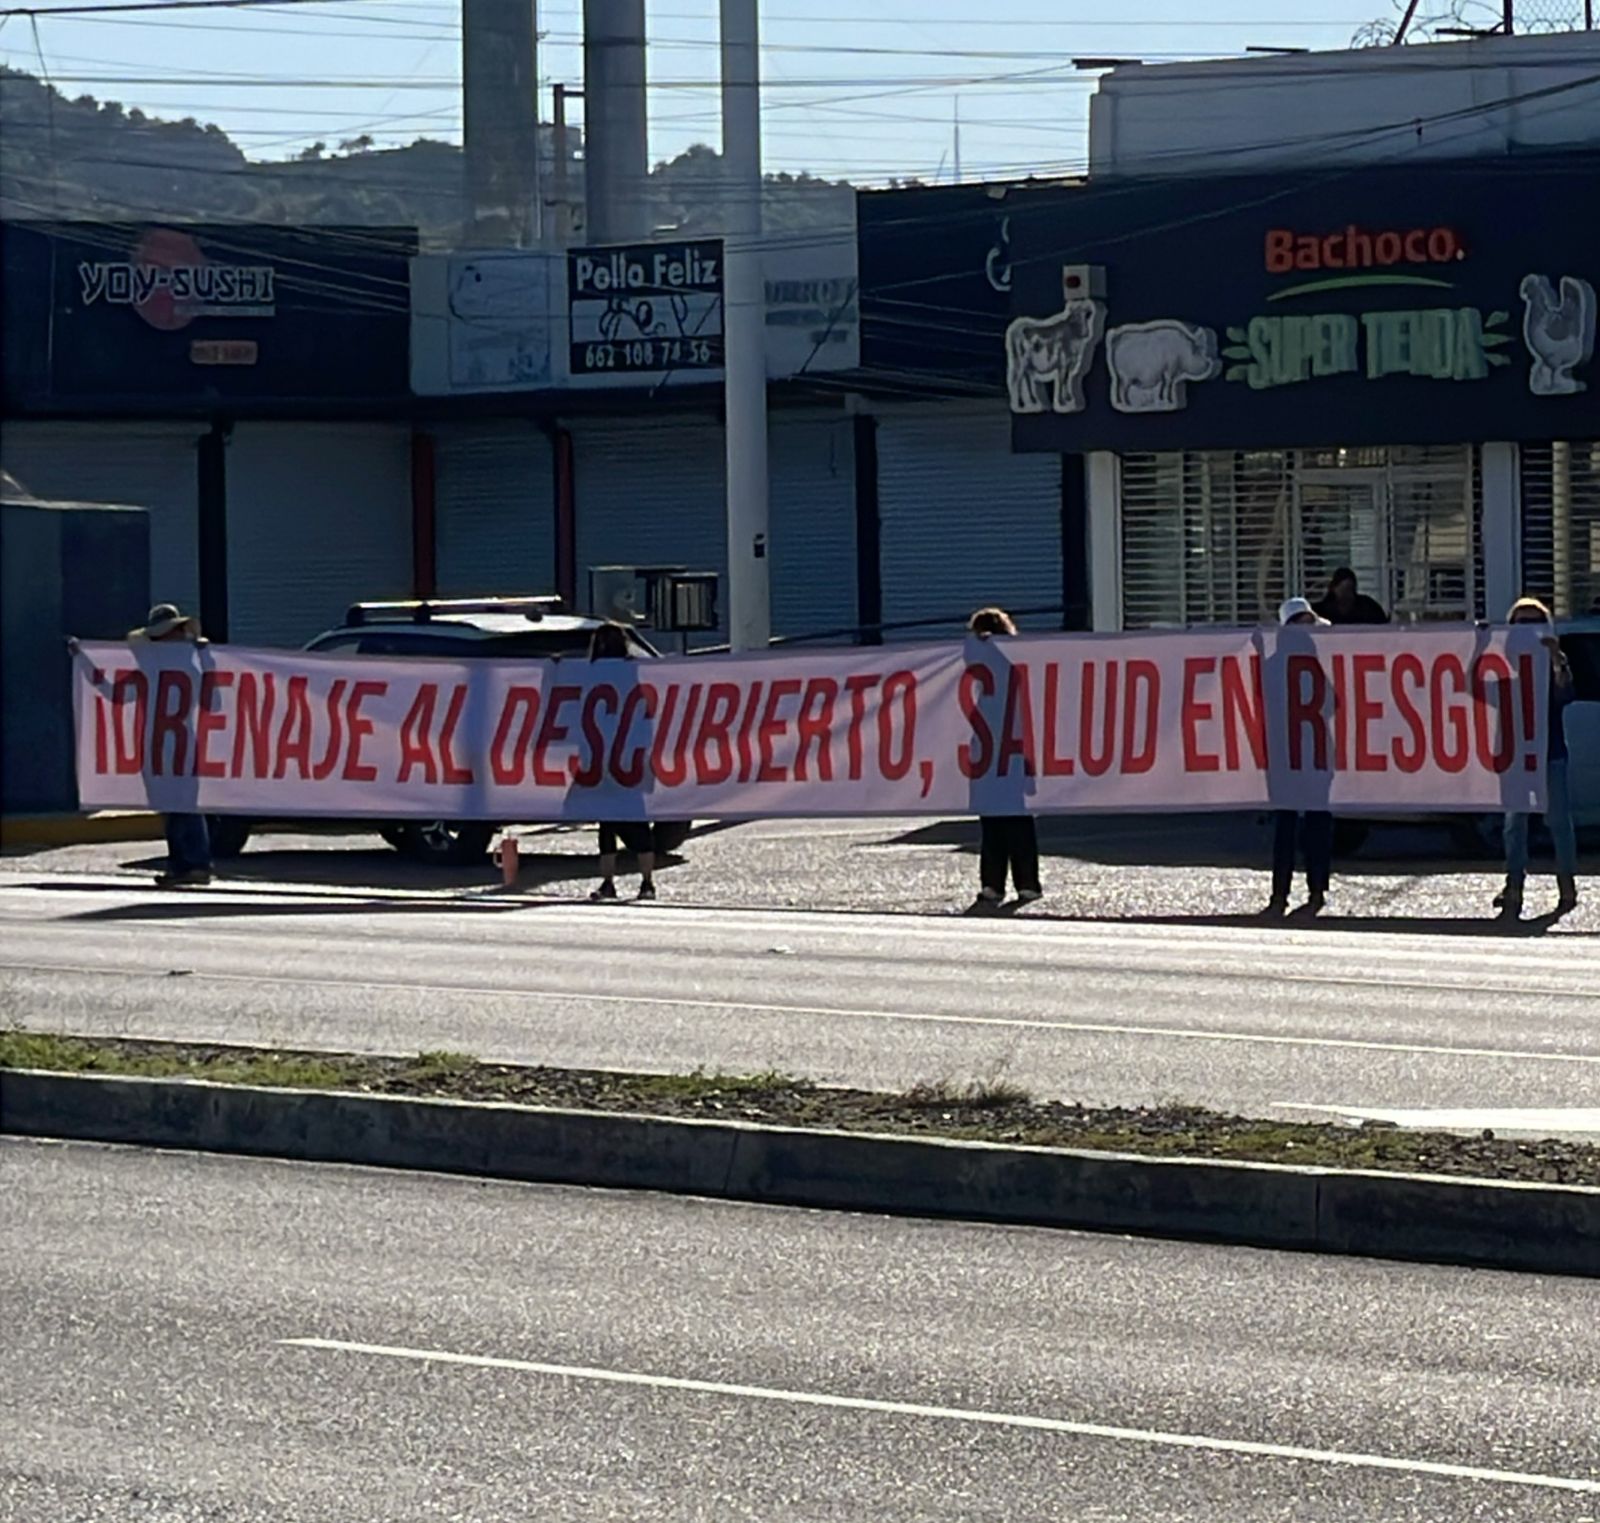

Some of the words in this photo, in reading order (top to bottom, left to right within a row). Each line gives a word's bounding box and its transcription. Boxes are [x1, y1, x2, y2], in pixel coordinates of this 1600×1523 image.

[77, 261, 275, 306] YOY-SUSHI
[577, 252, 644, 291] Pollo
[653, 248, 717, 288] Feliz
[585, 344, 615, 368] 662
[1247, 314, 1358, 390] SUPER
[1361, 307, 1489, 380] TIENDA
[94, 668, 388, 781] ¡DRENAJE
[396, 682, 474, 785] AL
[490, 669, 933, 798] DESCUBIERTO,
[957, 659, 1161, 780] SALUD
[1181, 654, 1269, 773] EN
[1287, 653, 1538, 774] RIESGO!
